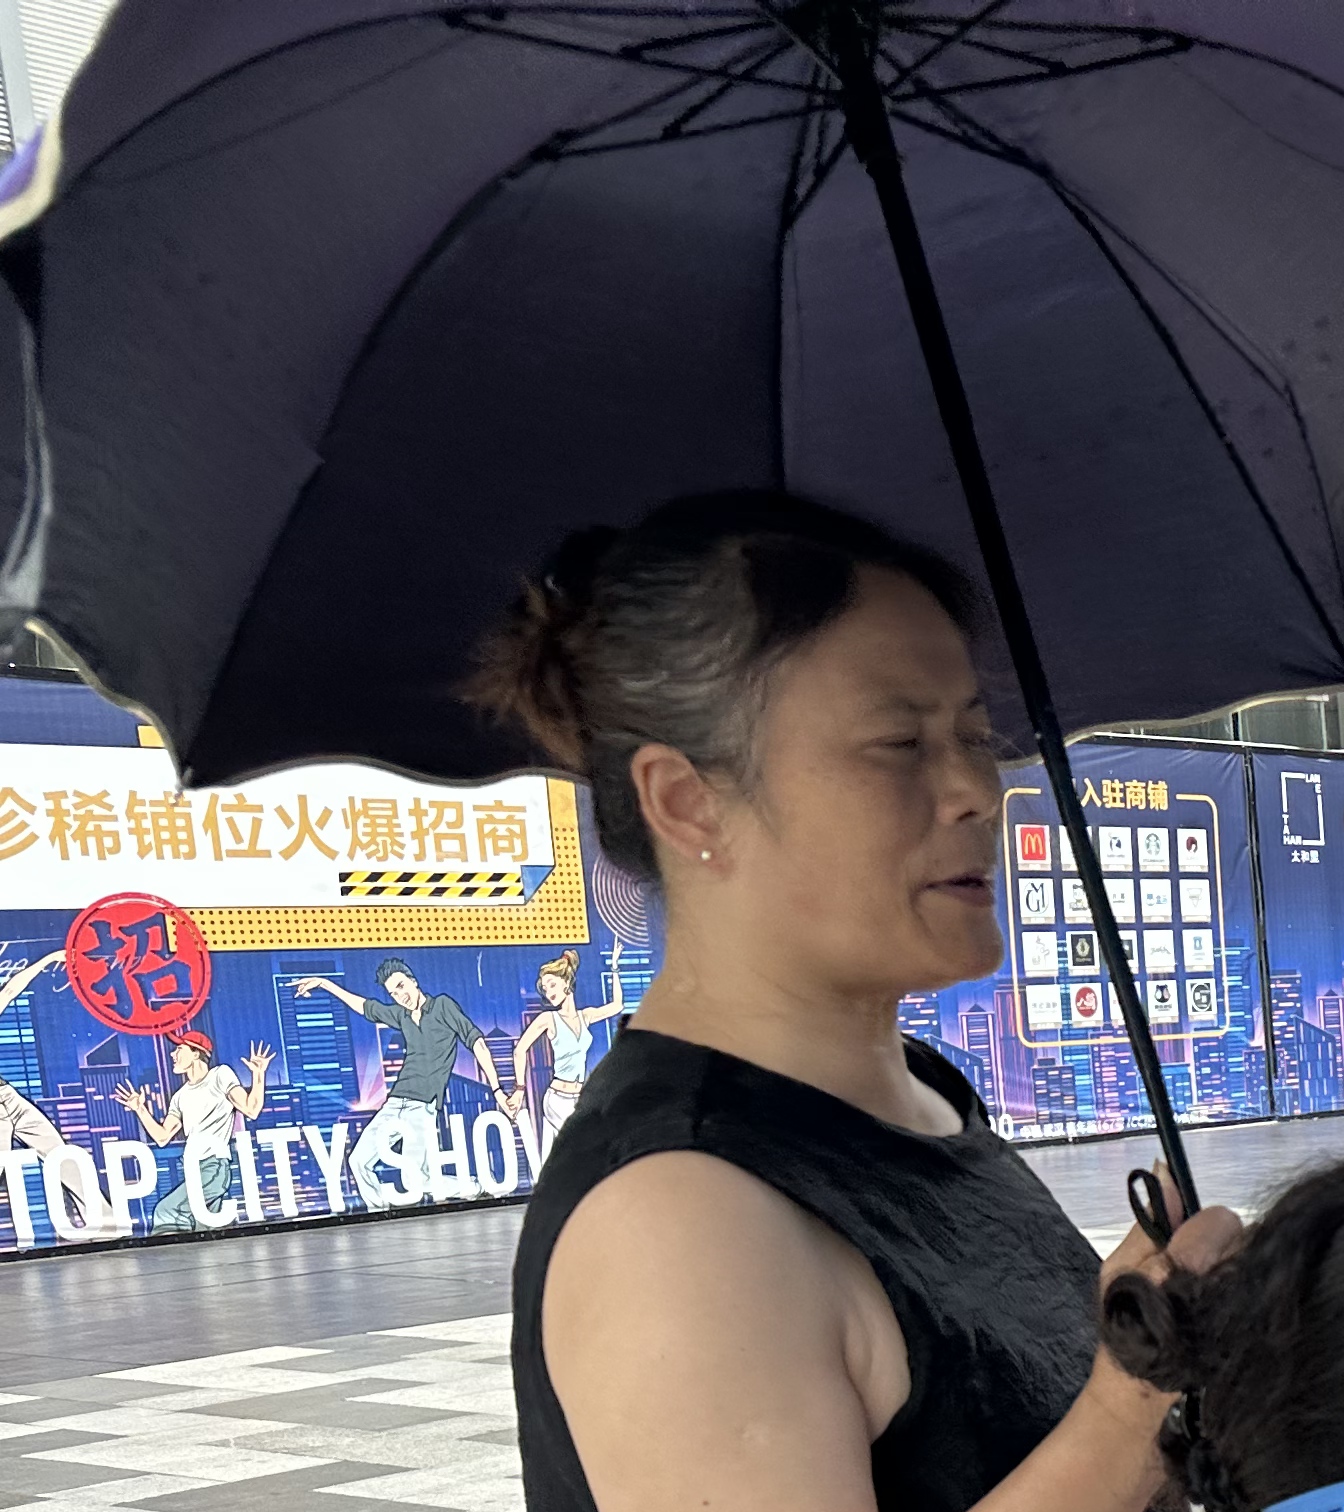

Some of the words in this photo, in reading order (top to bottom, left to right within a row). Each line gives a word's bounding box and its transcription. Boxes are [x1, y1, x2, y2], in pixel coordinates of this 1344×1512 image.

[1072, 778, 1170, 811] 入驻商铺
[82, 911, 196, 1020] 招
[0, 1140, 157, 1247] TOP
[184, 1124, 349, 1228] CITY
